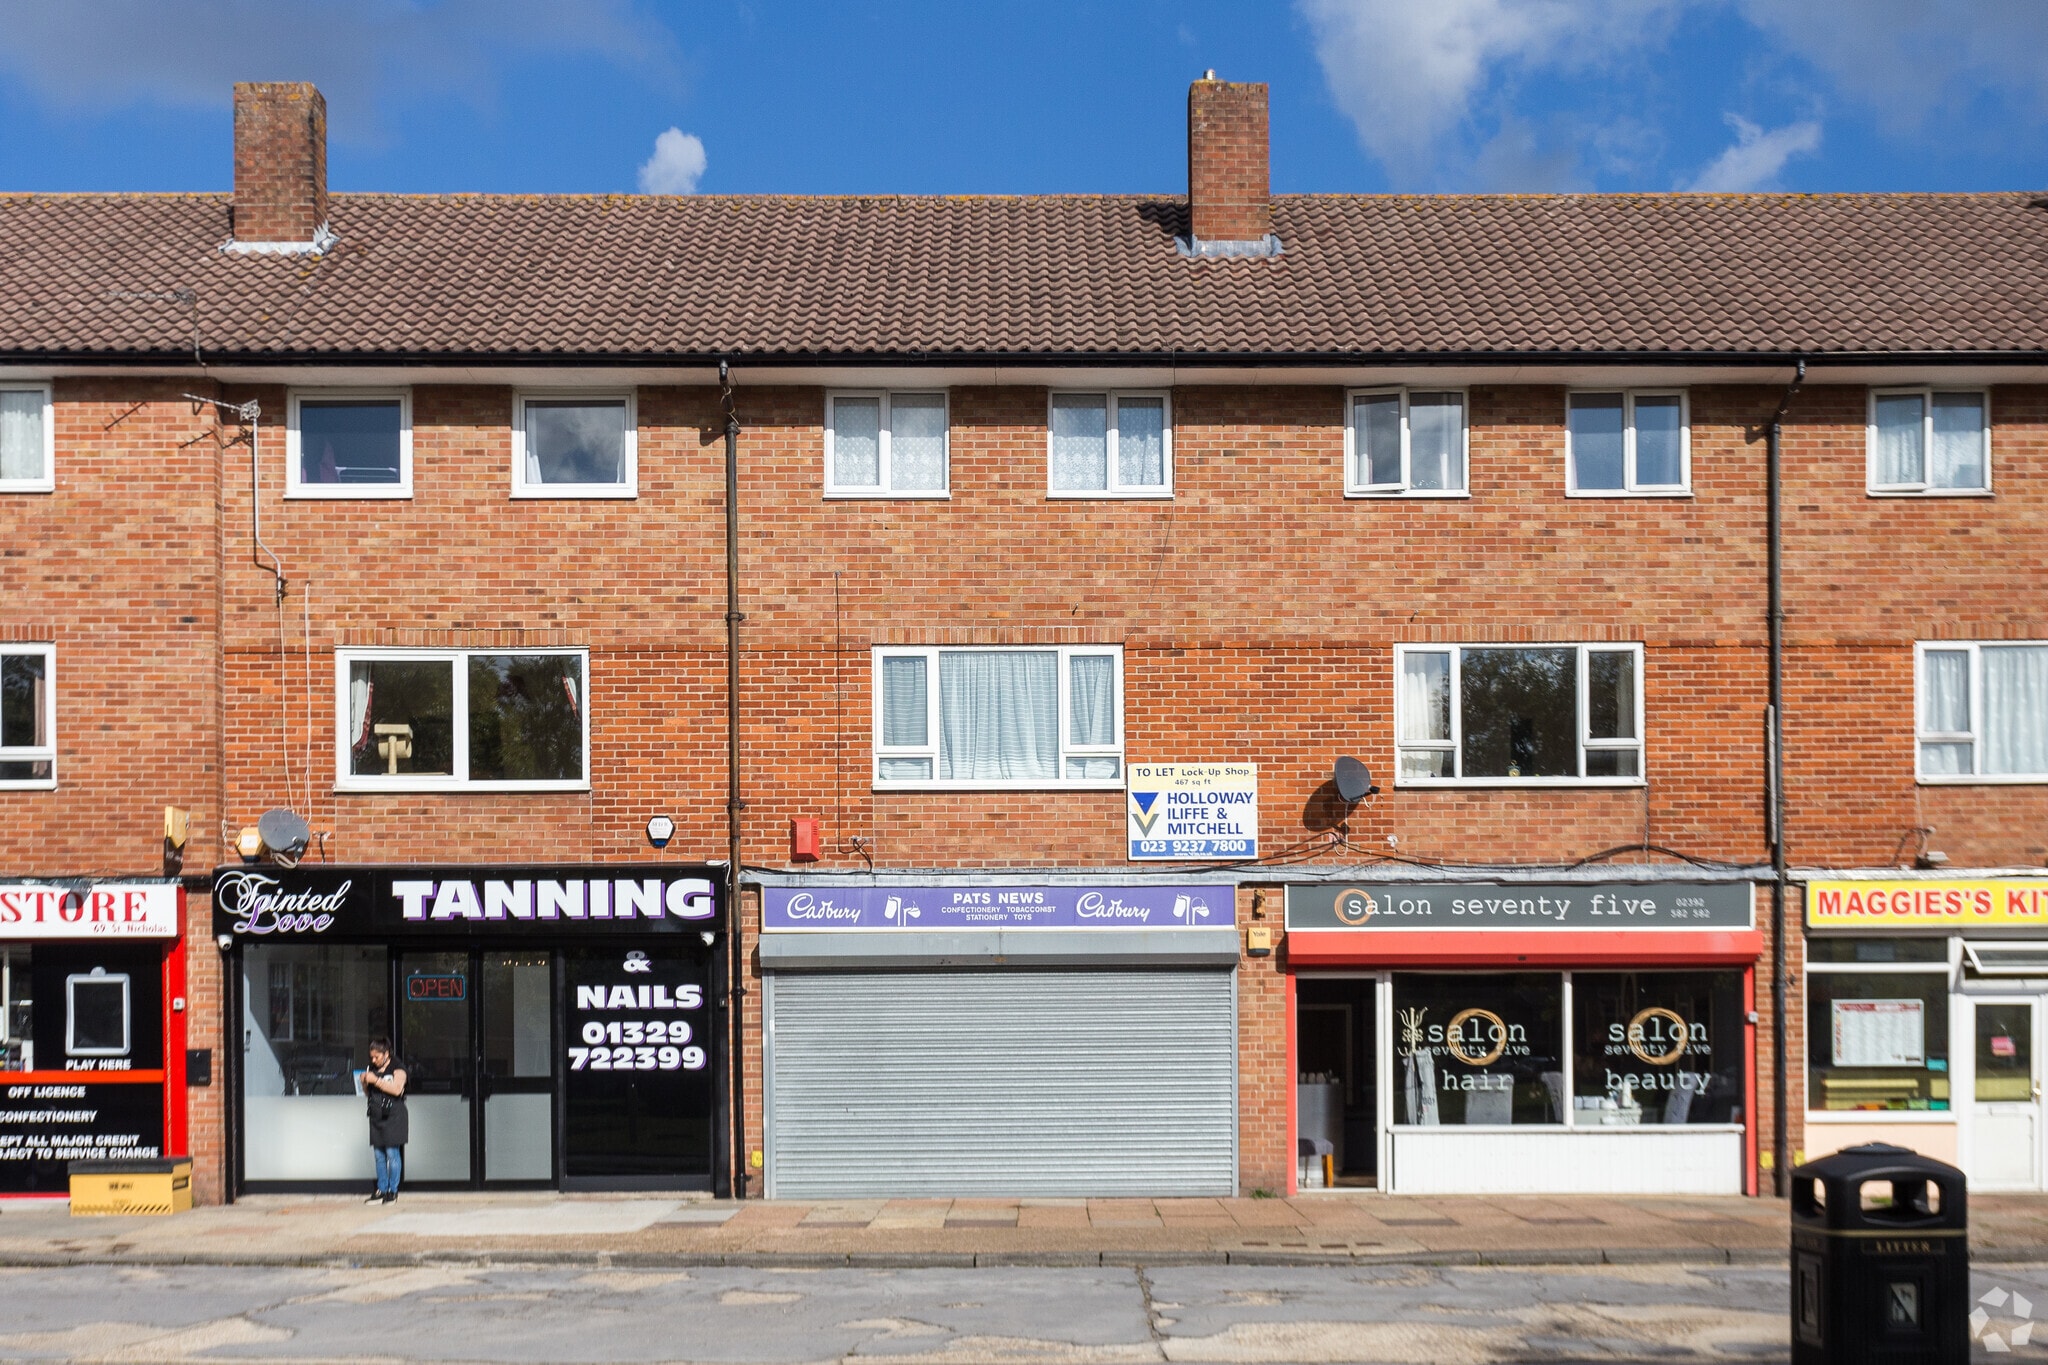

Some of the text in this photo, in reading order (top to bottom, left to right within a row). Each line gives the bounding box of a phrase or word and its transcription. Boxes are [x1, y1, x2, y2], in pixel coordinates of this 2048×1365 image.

[1136, 768, 1151, 777] TO
[1155, 768, 1175, 777] LET
[1225, 767, 1250, 776] Shop
[1167, 792, 1254, 805] HOLLOWAY
[1167, 807, 1228, 820] ILIFFE &
[1167, 822, 1243, 835] MITCHELL
[1140, 840, 1247, 852] 023 9237 7800
[215, 871, 352, 918] Tainted
[392, 878, 715, 921] TANNING
[953, 892, 1044, 904] PATS NEWS
[1818, 891, 2048, 914] MAGGIES'S KI
[0, 891, 147, 923] STORE
[233, 900, 335, 934] Love
[786, 892, 861, 923] Cadbury
[941, 906, 1001, 914] CONFECTIONERY
[965, 913, 1008, 921] STATIONERY
[1076, 891, 1151, 922] Cadbury
[1348, 895, 1656, 919] salon seventy five
[93, 923, 168, 933] 69 St Nicholas
[623, 951, 651, 973] &
[410, 979, 463, 997] OPEN
[577, 984, 703, 1009] NAILS
[582, 1020, 693, 1045] 01329
[1428, 1018, 1527, 1042] salon
[1608, 1017, 1708, 1041] salon
[65, 1059, 132, 1070] PLAY HERE
[568, 1046, 706, 1071] 722399
[1442, 1069, 1510, 1090] hair
[1604, 1068, 1712, 1095] beauty
[8, 1086, 86, 1098] OFF LICENCE
[25, 1135, 49, 1147] ALL
[51, 1135, 93, 1147] MAJOR
[95, 1135, 140, 1147] CREDIT
[35, 1147, 53, 1160] TO
[55, 1147, 107, 1160] SERVICE
[108, 1147, 159, 1159] CHARGE
